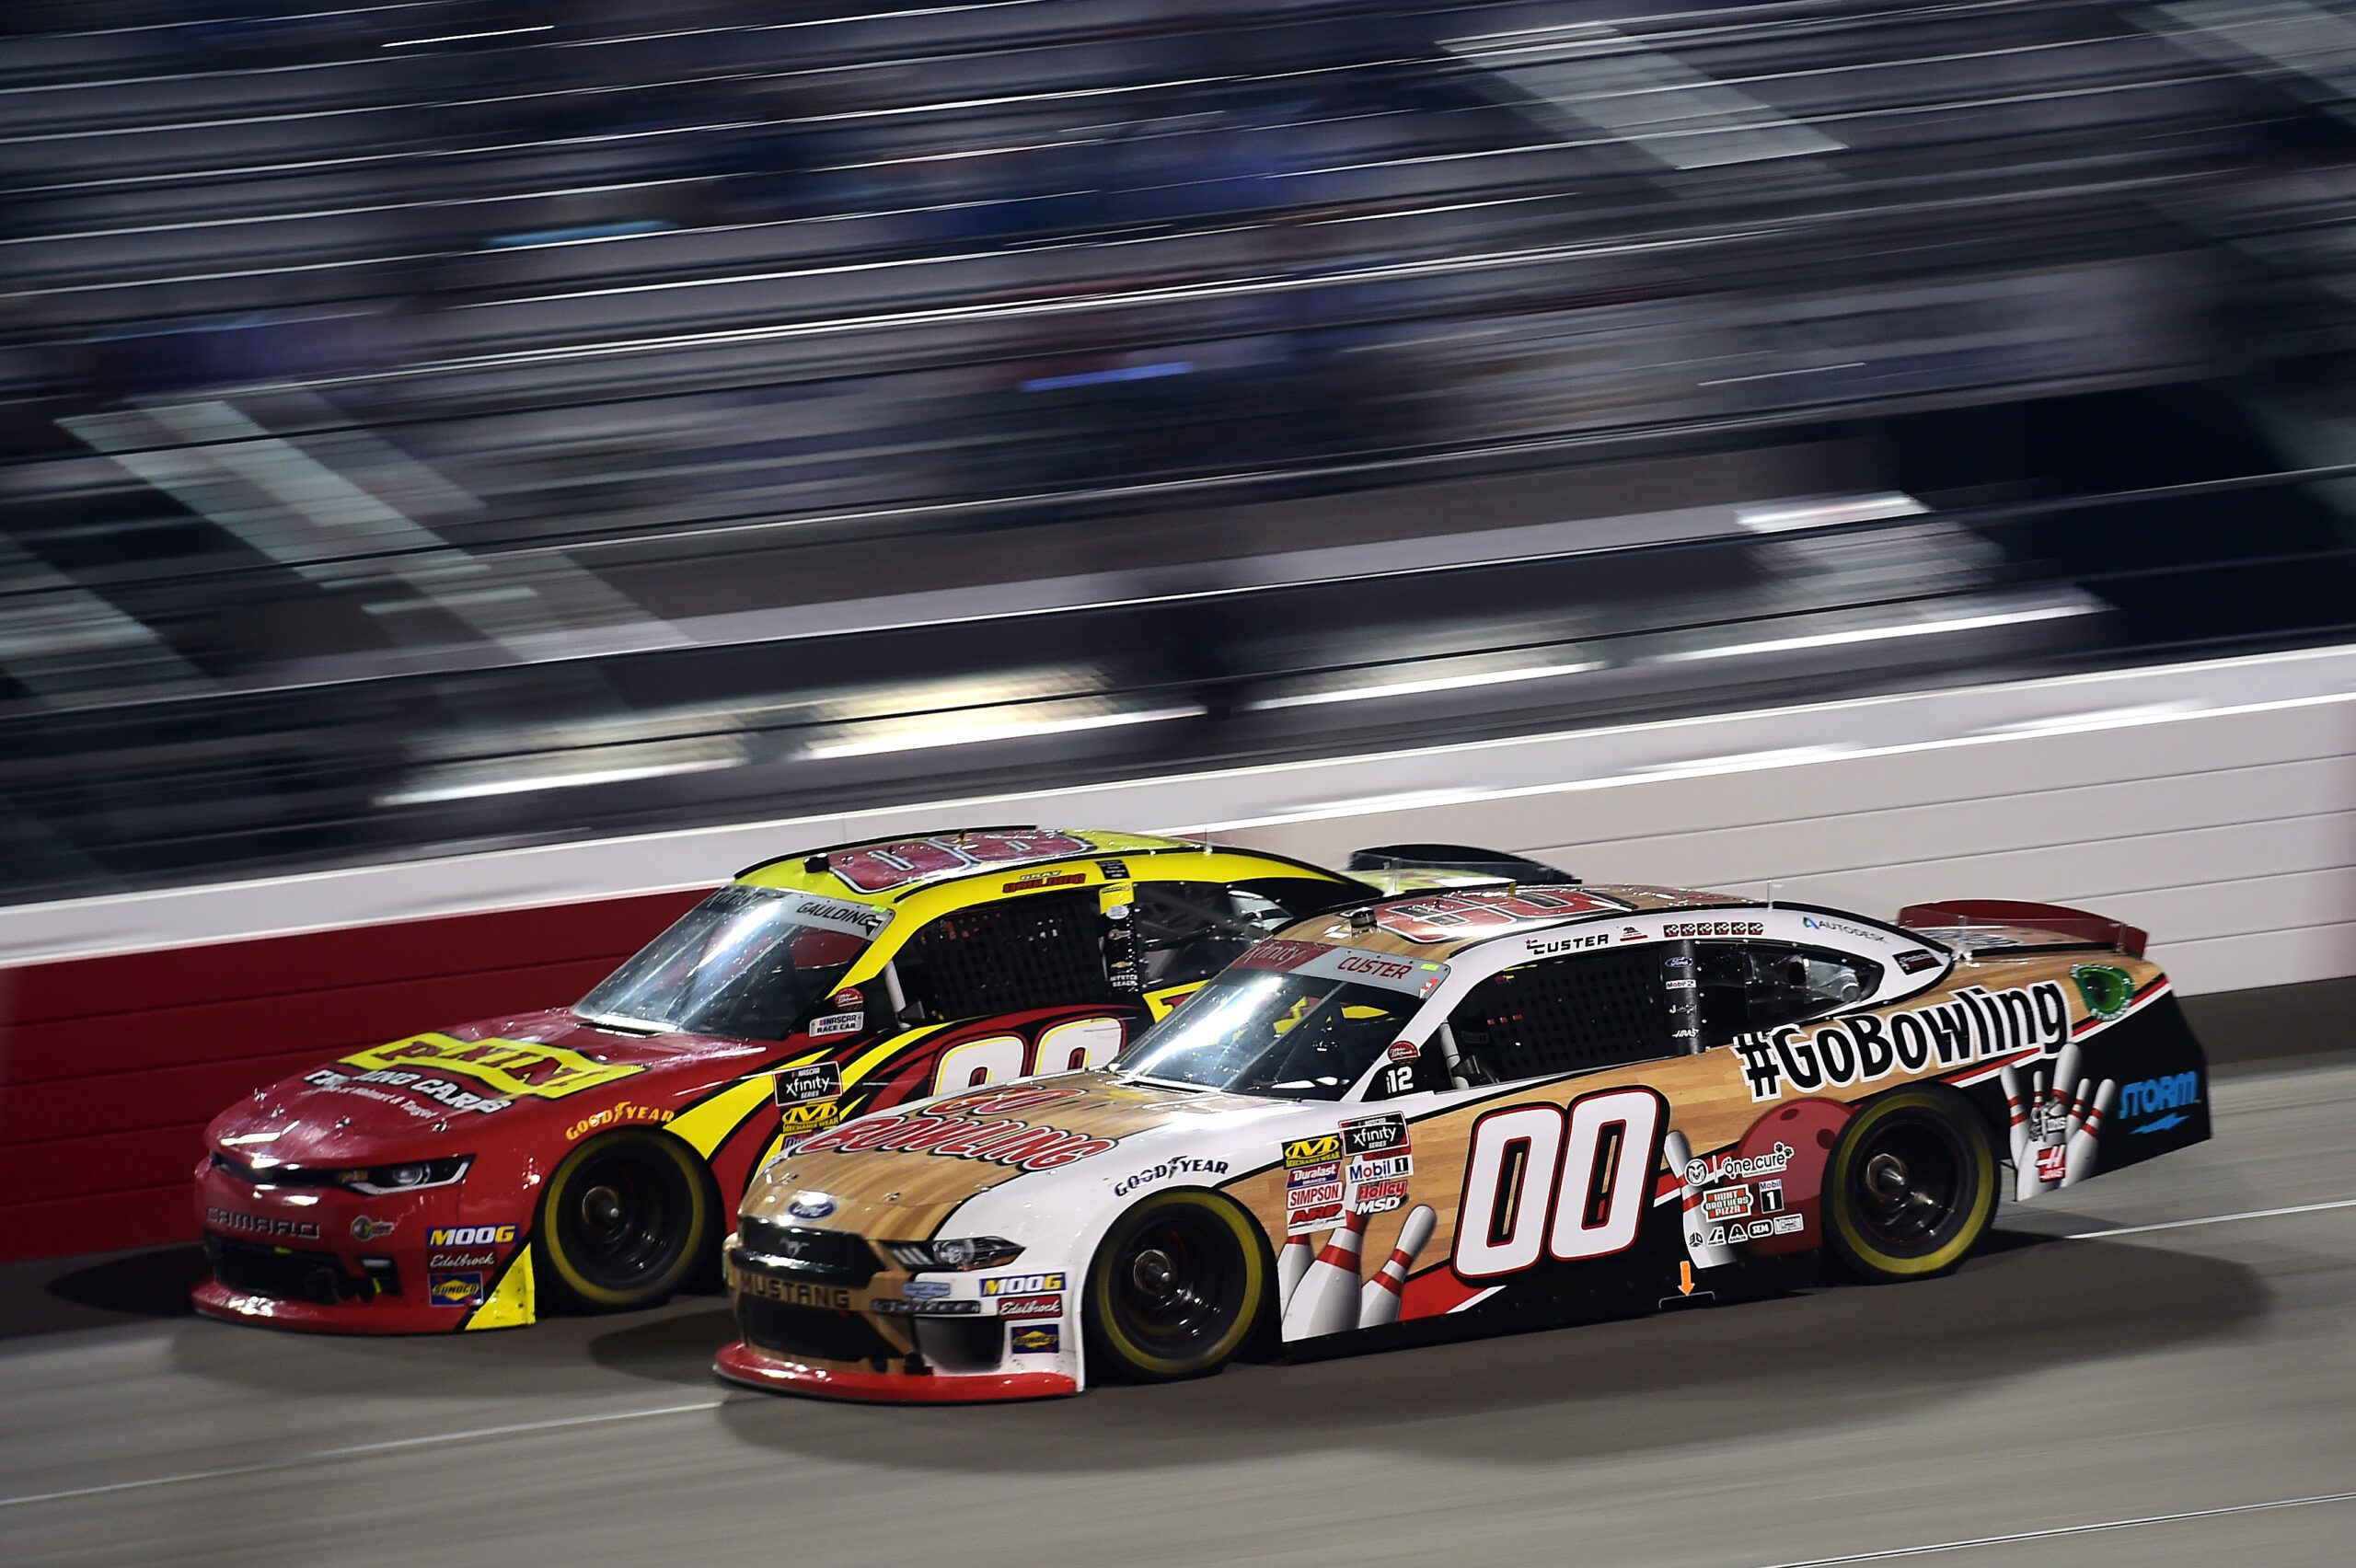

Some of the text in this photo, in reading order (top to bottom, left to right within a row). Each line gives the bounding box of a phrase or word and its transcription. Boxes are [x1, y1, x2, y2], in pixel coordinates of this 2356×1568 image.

[1021, 870, 1061, 880] GRAY
[796, 902, 876, 927] GAULDING
[1526, 933, 1610, 956] CUSTER
[1337, 956, 1413, 980] CUSTER
[817, 1022, 856, 1033] RACE CAR
[826, 1014, 857, 1024] NASCAR
[1735, 981, 2069, 1100] #GoBowling
[798, 1066, 820, 1077] NASCAR
[1388, 1066, 1414, 1093] 12
[786, 1076, 830, 1097] xfinity
[801, 1090, 820, 1099] SERIES
[2119, 1070, 2198, 1119] STORM
[923, 1084, 1088, 1115] GO
[565, 1101, 676, 1140] GOODYEAR
[794, 1115, 1117, 1171] BOWLING
[1353, 1125, 1397, 1147] xfinity
[1369, 1140, 1387, 1149] SERIES
[1292, 1163, 1336, 1182] Duralast
[1349, 1159, 1391, 1181] Mobil
[1725, 1159, 1751, 1175] one
[1755, 1153, 1785, 1169] cure
[1114, 1155, 1229, 1196] GOODYEAR
[1453, 1088, 1659, 1279] 00
[1760, 1180, 1782, 1191] Mobil
[1290, 1183, 1340, 1206] SIMPSON
[1357, 1181, 1407, 1201] Holley
[1714, 1190, 1738, 1202] HUNT
[1766, 1191, 1775, 1210] 1
[1288, 1203, 1344, 1225] ARP
[1356, 1195, 1401, 1216] MSD
[1705, 1196, 1750, 1211] BROTHERS
[1715, 1205, 1741, 1216] PIZZA
[207, 1206, 319, 1239] CAMARO
[1752, 1223, 1770, 1234] SEM
[430, 1226, 516, 1246] MOOG
[430, 1251, 495, 1268] Edelbrock
[740, 1274, 849, 1309] MUSTANG
[983, 1274, 1064, 1296] MOOG
[999, 1298, 1061, 1315] Edelbrock
